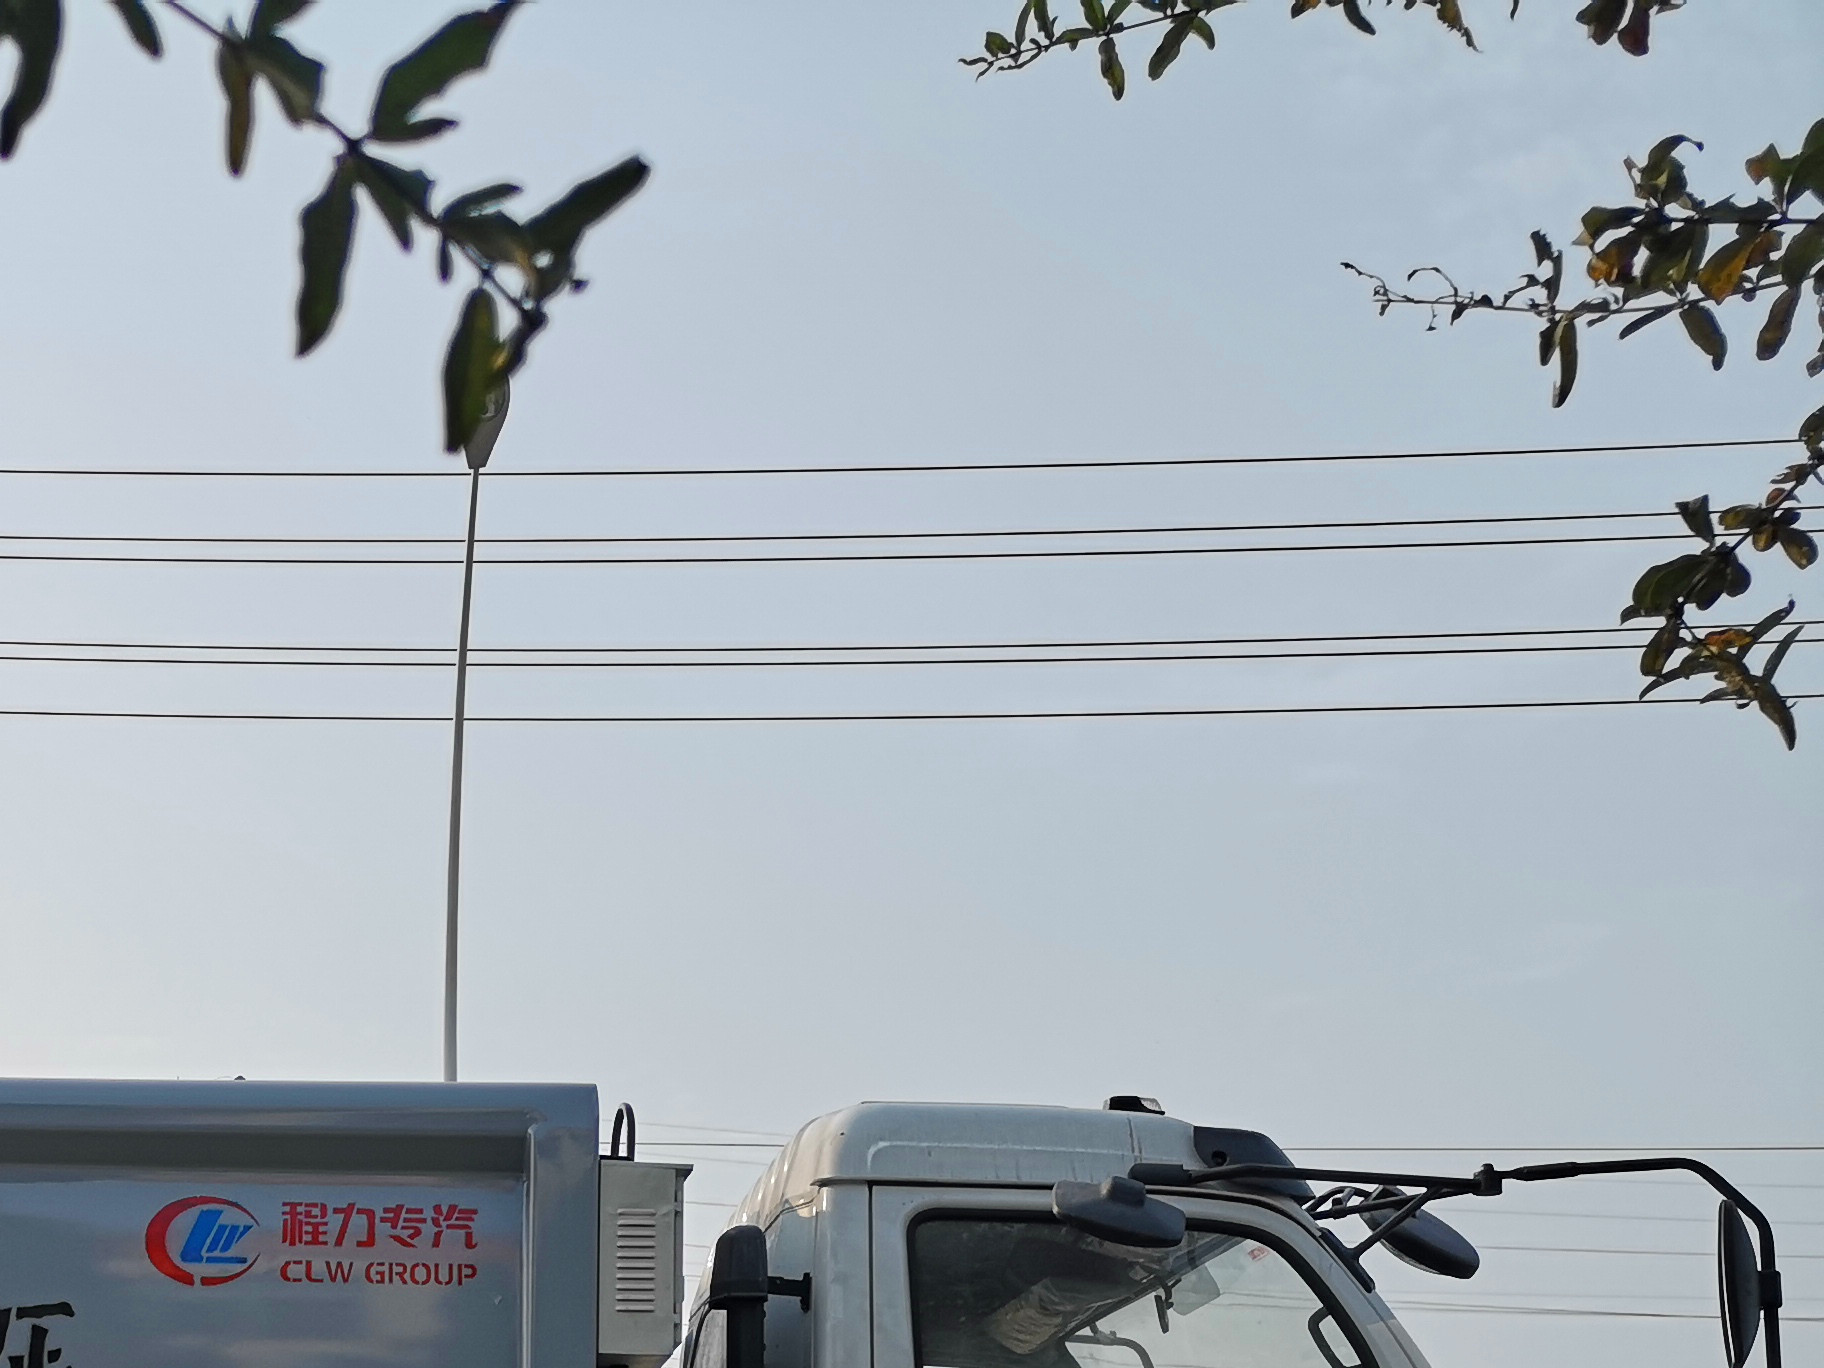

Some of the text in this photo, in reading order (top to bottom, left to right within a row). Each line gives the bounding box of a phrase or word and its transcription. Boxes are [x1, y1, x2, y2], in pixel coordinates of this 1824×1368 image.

[281, 1201, 479, 1250] 程力专汽
[279, 1260, 479, 1287] CLW GROUP
